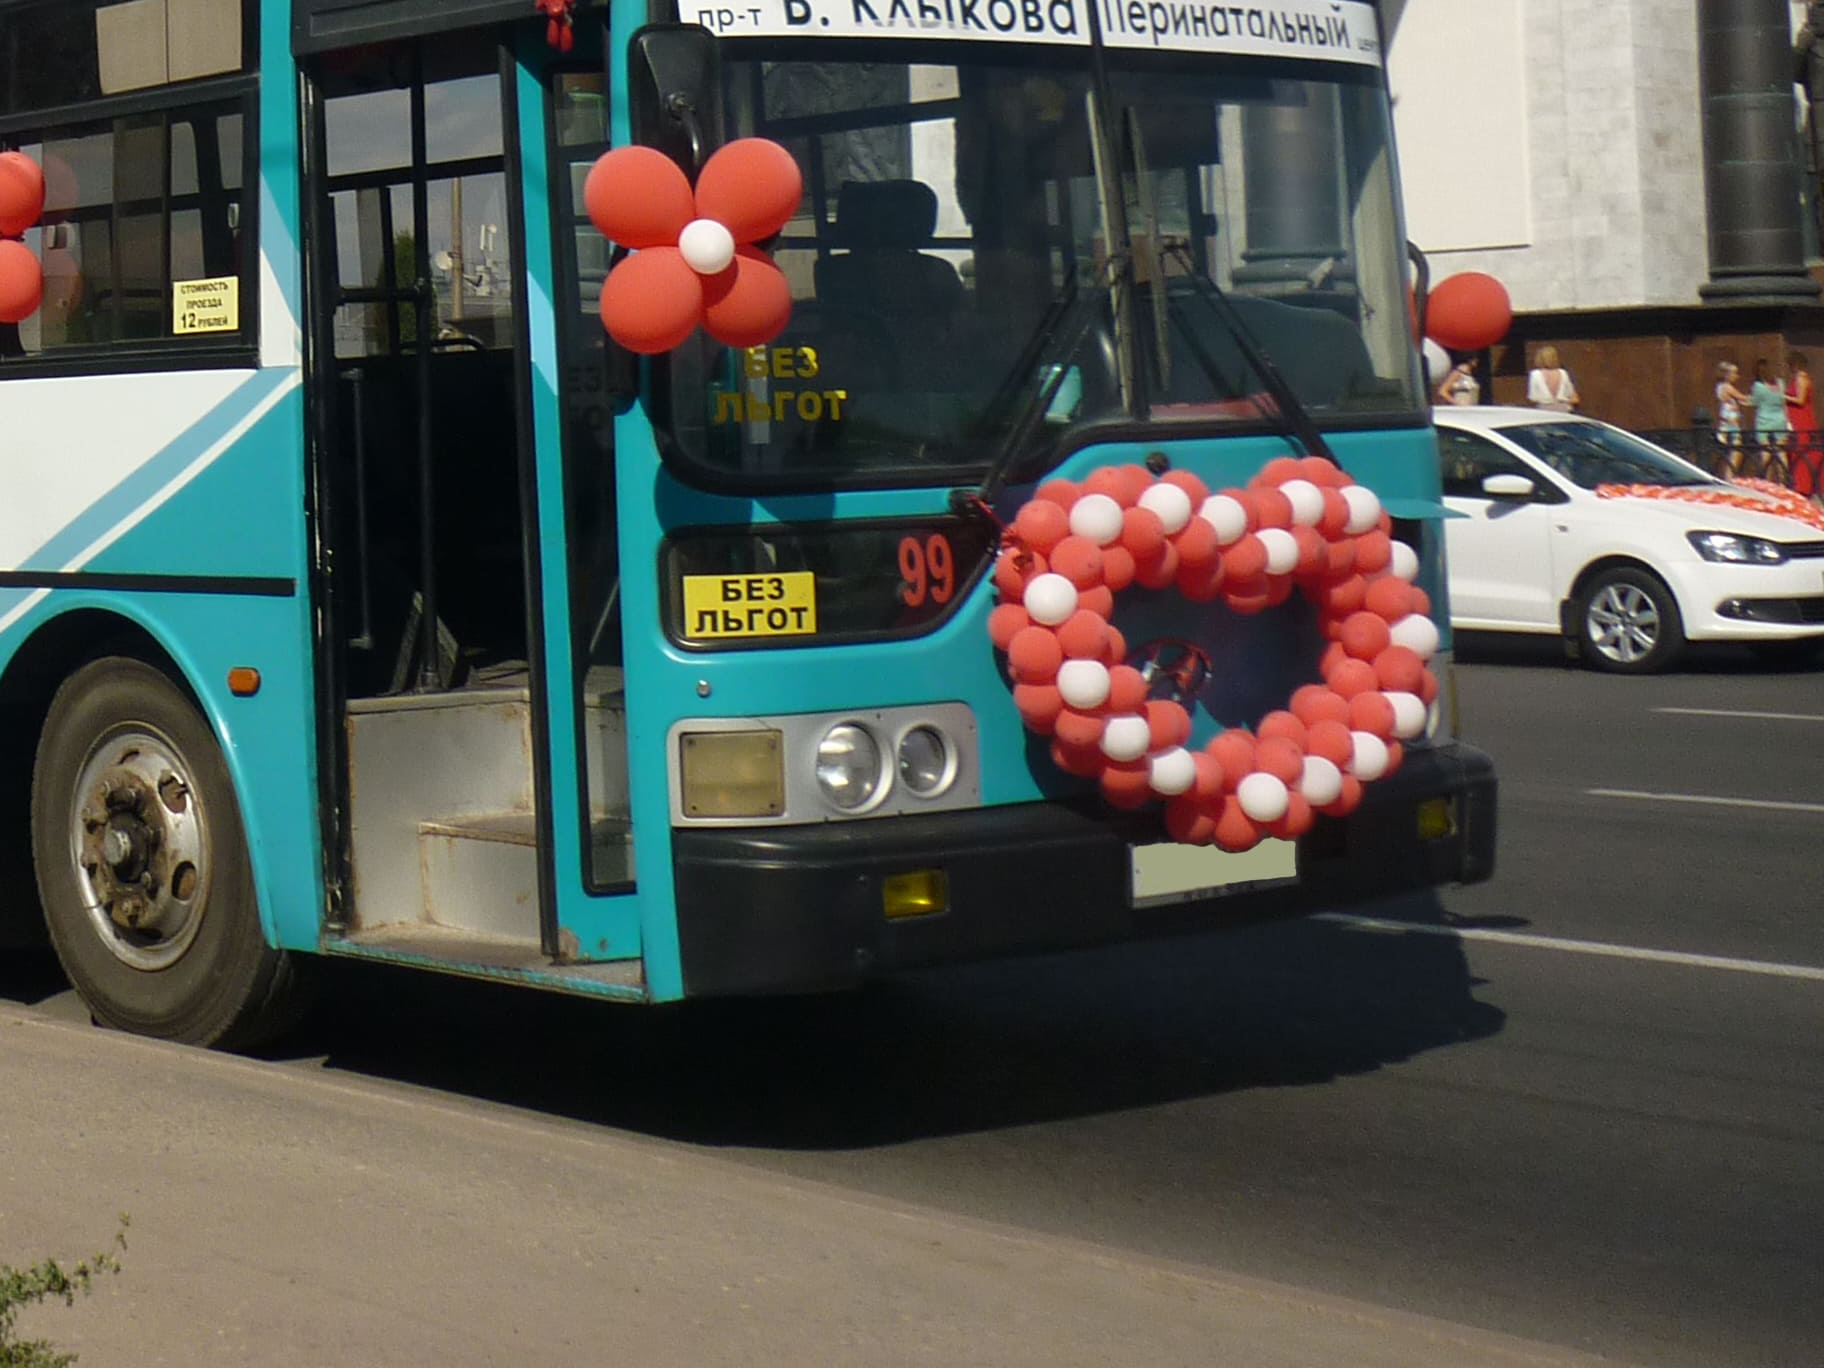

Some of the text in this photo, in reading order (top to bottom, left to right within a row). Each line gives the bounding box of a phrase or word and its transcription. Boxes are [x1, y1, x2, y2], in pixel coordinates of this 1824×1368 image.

[698, 7, 762, 32] пр-т
[180, 313, 196, 329] 12
[744, 345, 820, 379] БЕЗ
[713, 389, 848, 425] ЛЬГОТ
[898, 533, 954, 608] 99
[722, 578, 786, 603] БЕЗ
[695, 606, 809, 633] ЛЬГОТ
